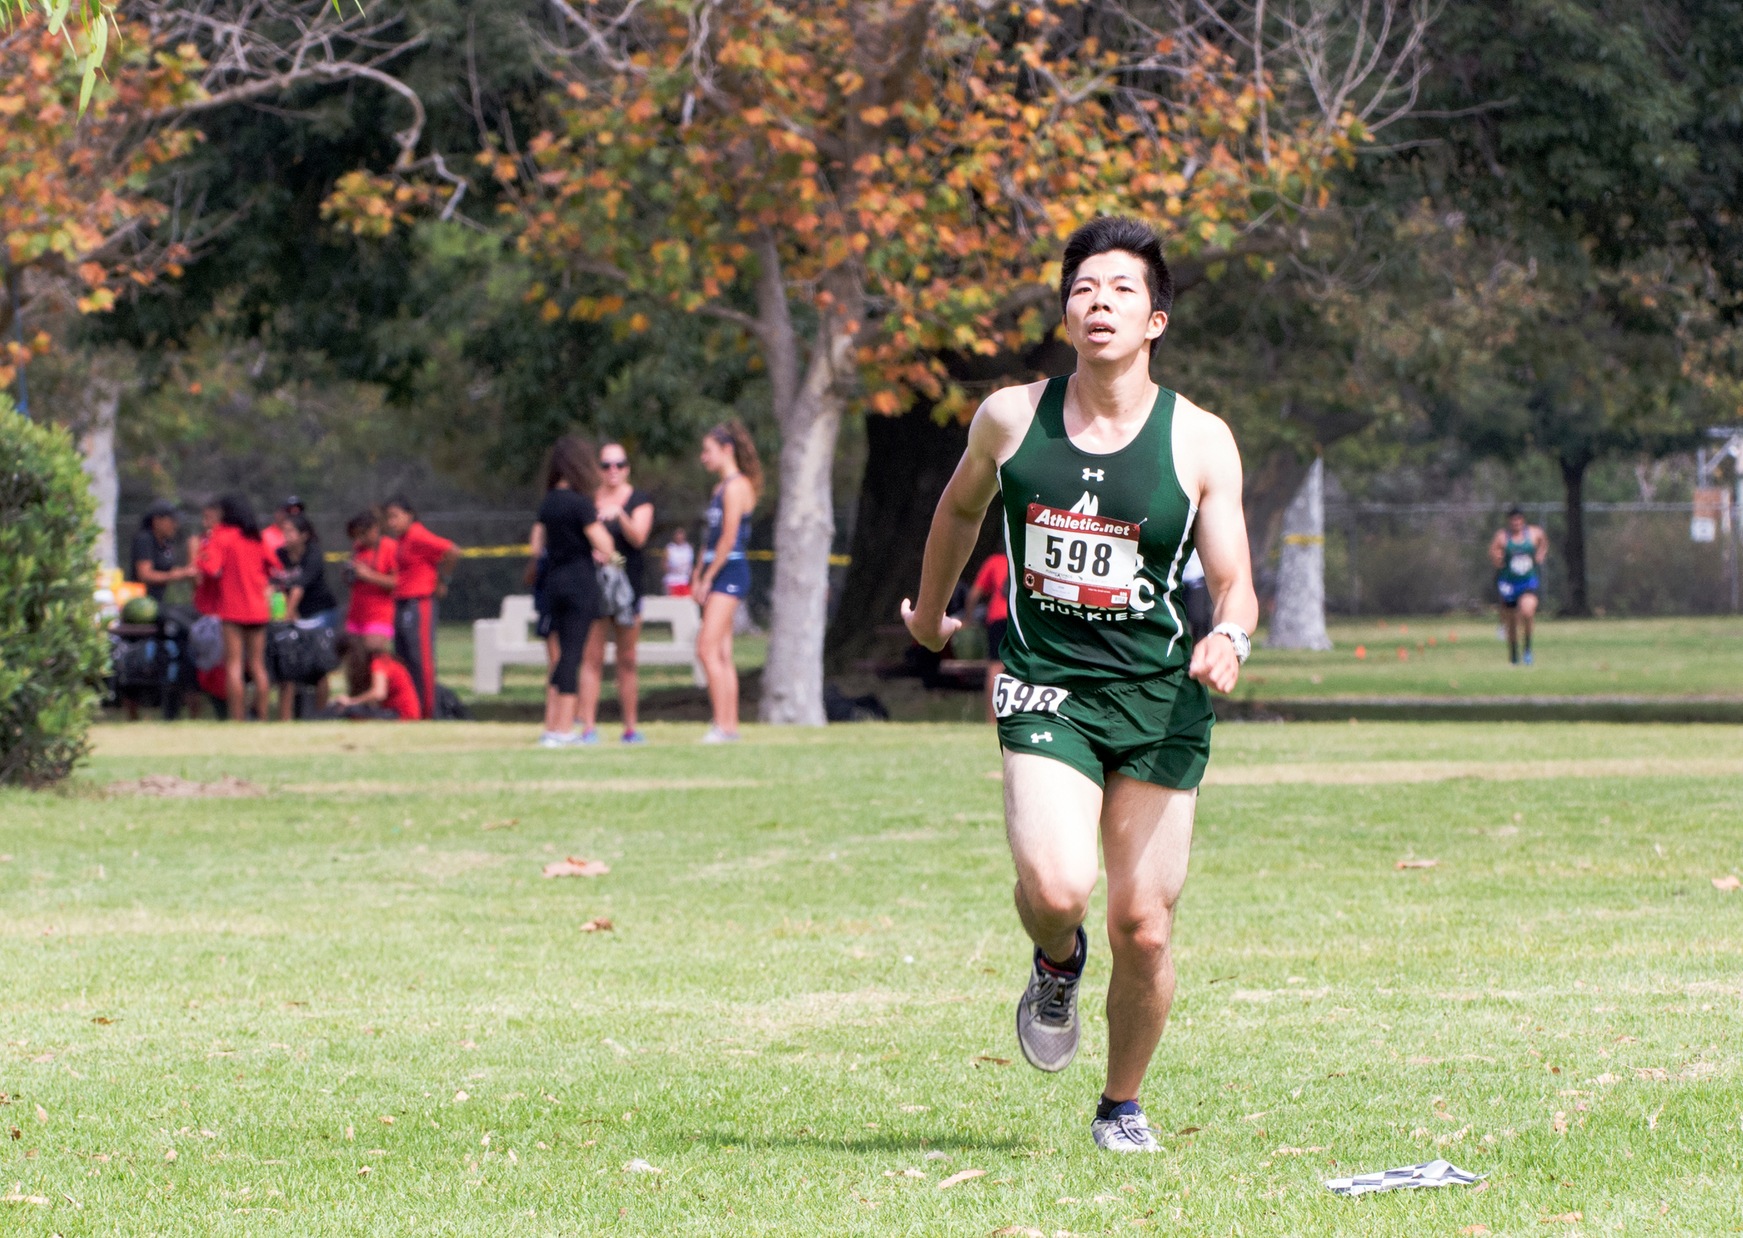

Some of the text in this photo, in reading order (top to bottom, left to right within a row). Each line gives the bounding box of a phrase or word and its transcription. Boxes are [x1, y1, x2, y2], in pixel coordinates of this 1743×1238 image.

[1035, 508, 1131, 536] Athletic.net
[1045, 534, 1112, 577] 598
[996, 677, 1058, 714] 598
